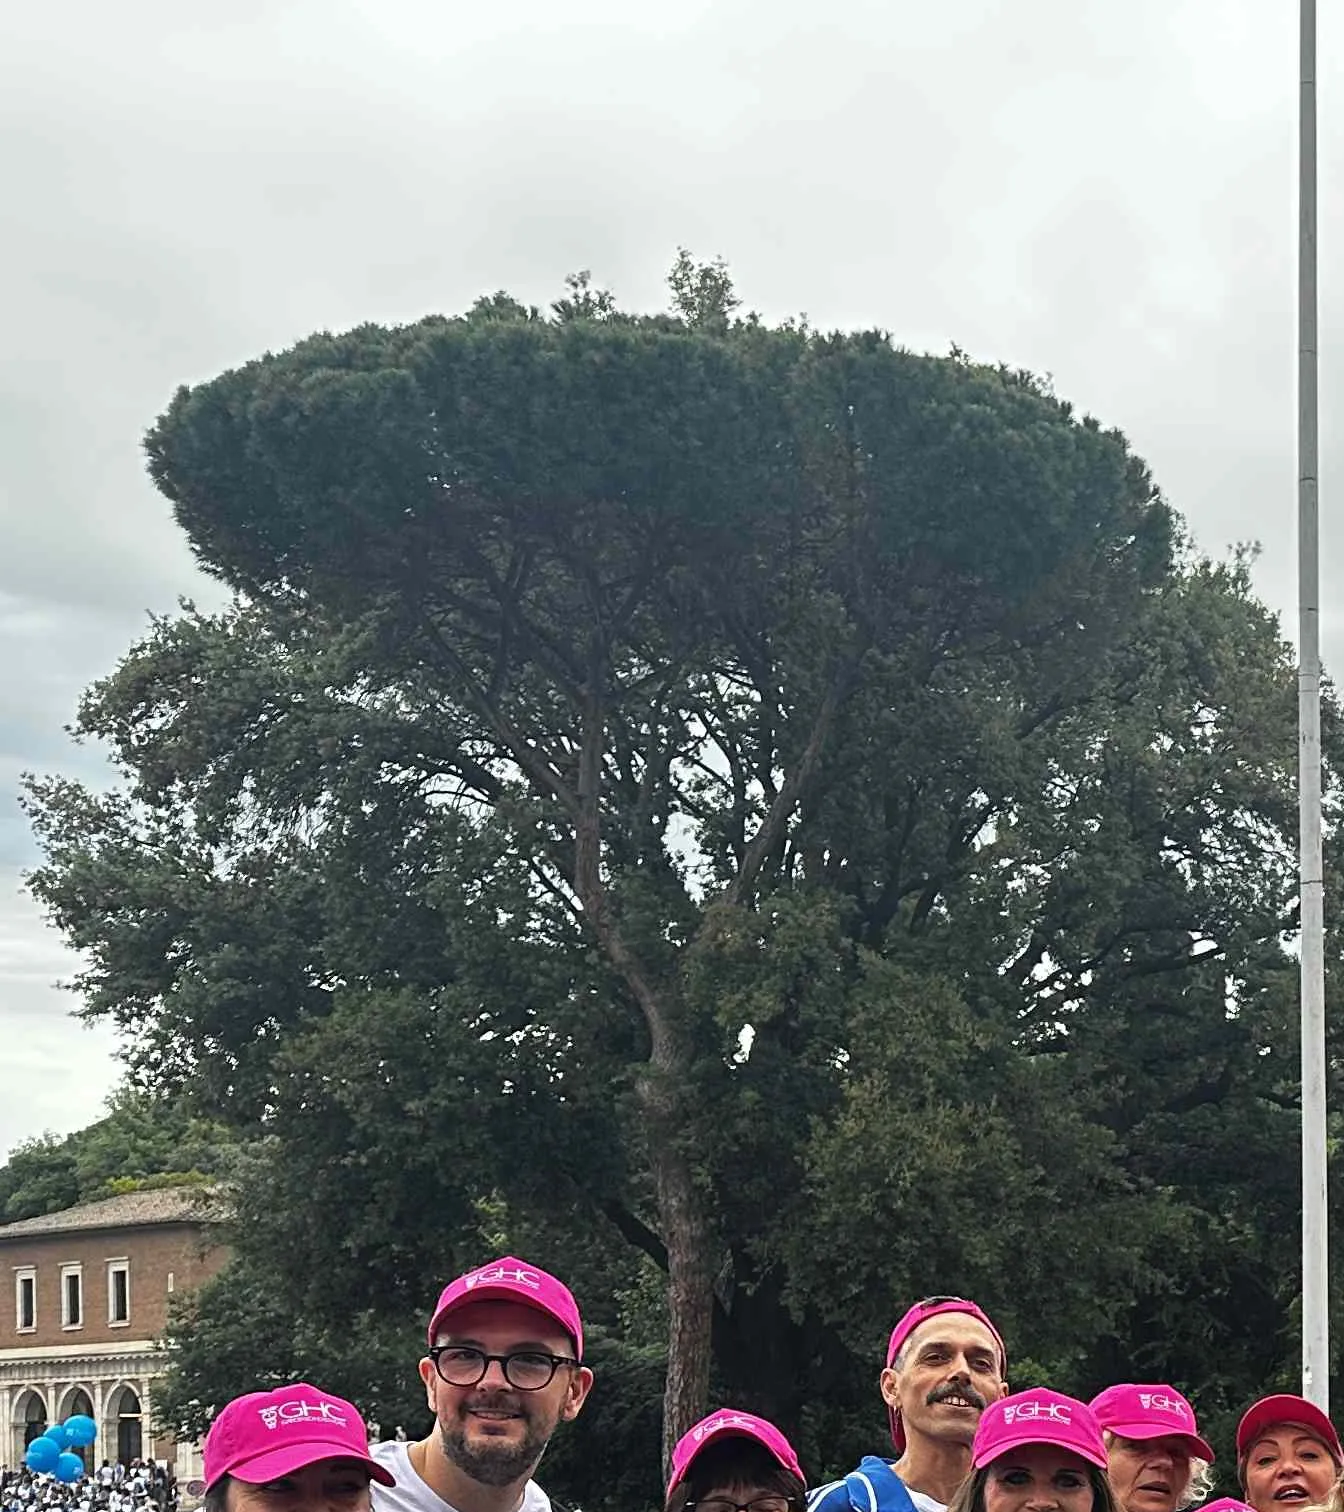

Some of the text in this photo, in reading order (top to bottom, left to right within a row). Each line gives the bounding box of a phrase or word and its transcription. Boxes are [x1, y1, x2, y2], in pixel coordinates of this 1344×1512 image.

[478, 1266, 541, 1287] GHC
[278, 1400, 346, 1423] GHC
[1017, 1401, 1072, 1419] GHC
[1152, 1395, 1188, 1414] GHC
